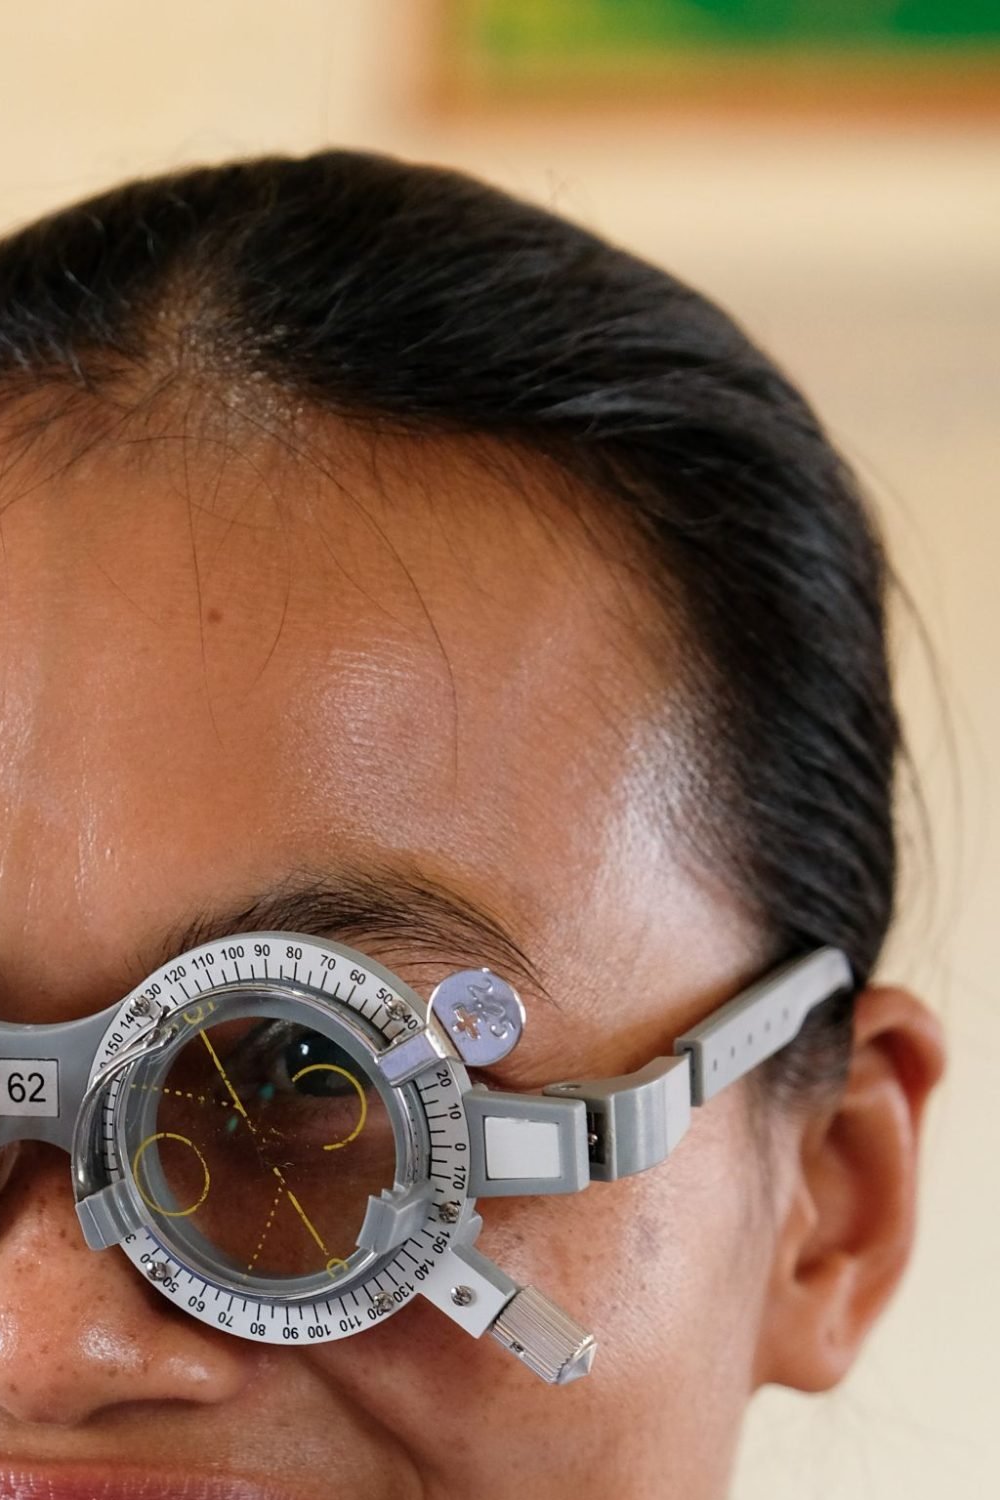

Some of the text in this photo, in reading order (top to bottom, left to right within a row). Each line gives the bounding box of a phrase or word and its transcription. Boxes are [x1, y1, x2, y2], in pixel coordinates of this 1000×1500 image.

[220, 945, 245, 961] 100
[254, 944, 271, 957] 90
[286, 946, 303, 960] 80
[191, 952, 215, 970] 110
[320, 954, 337, 971] 70
[164, 965, 187, 985] 120
[349, 969, 366, 986] 60
[145, 983, 162, 1000] 30
[402, 1013, 419, 1031] 40
[105, 1032, 124, 1057] 150
[436, 1069, 451, 1088] 20
[7, 1072, 47, 1103] 62
[448, 1103, 462, 1120] 10
[454, 1142, 467, 1152] 0
[452, 1165, 466, 1190] 170
[432, 1230, 450, 1254] 150
[414, 1259, 435, 1281] 140
[162, 1276, 179, 1294] 50
[392, 1281, 415, 1303] 130
[187, 1296, 206, 1312] 60
[217, 1311, 234, 1328] 70
[339, 1315, 362, 1332] 110
[250, 1322, 266, 1336] 80
[282, 1327, 299, 1339] 90
[308, 1324, 331, 1338] 100
